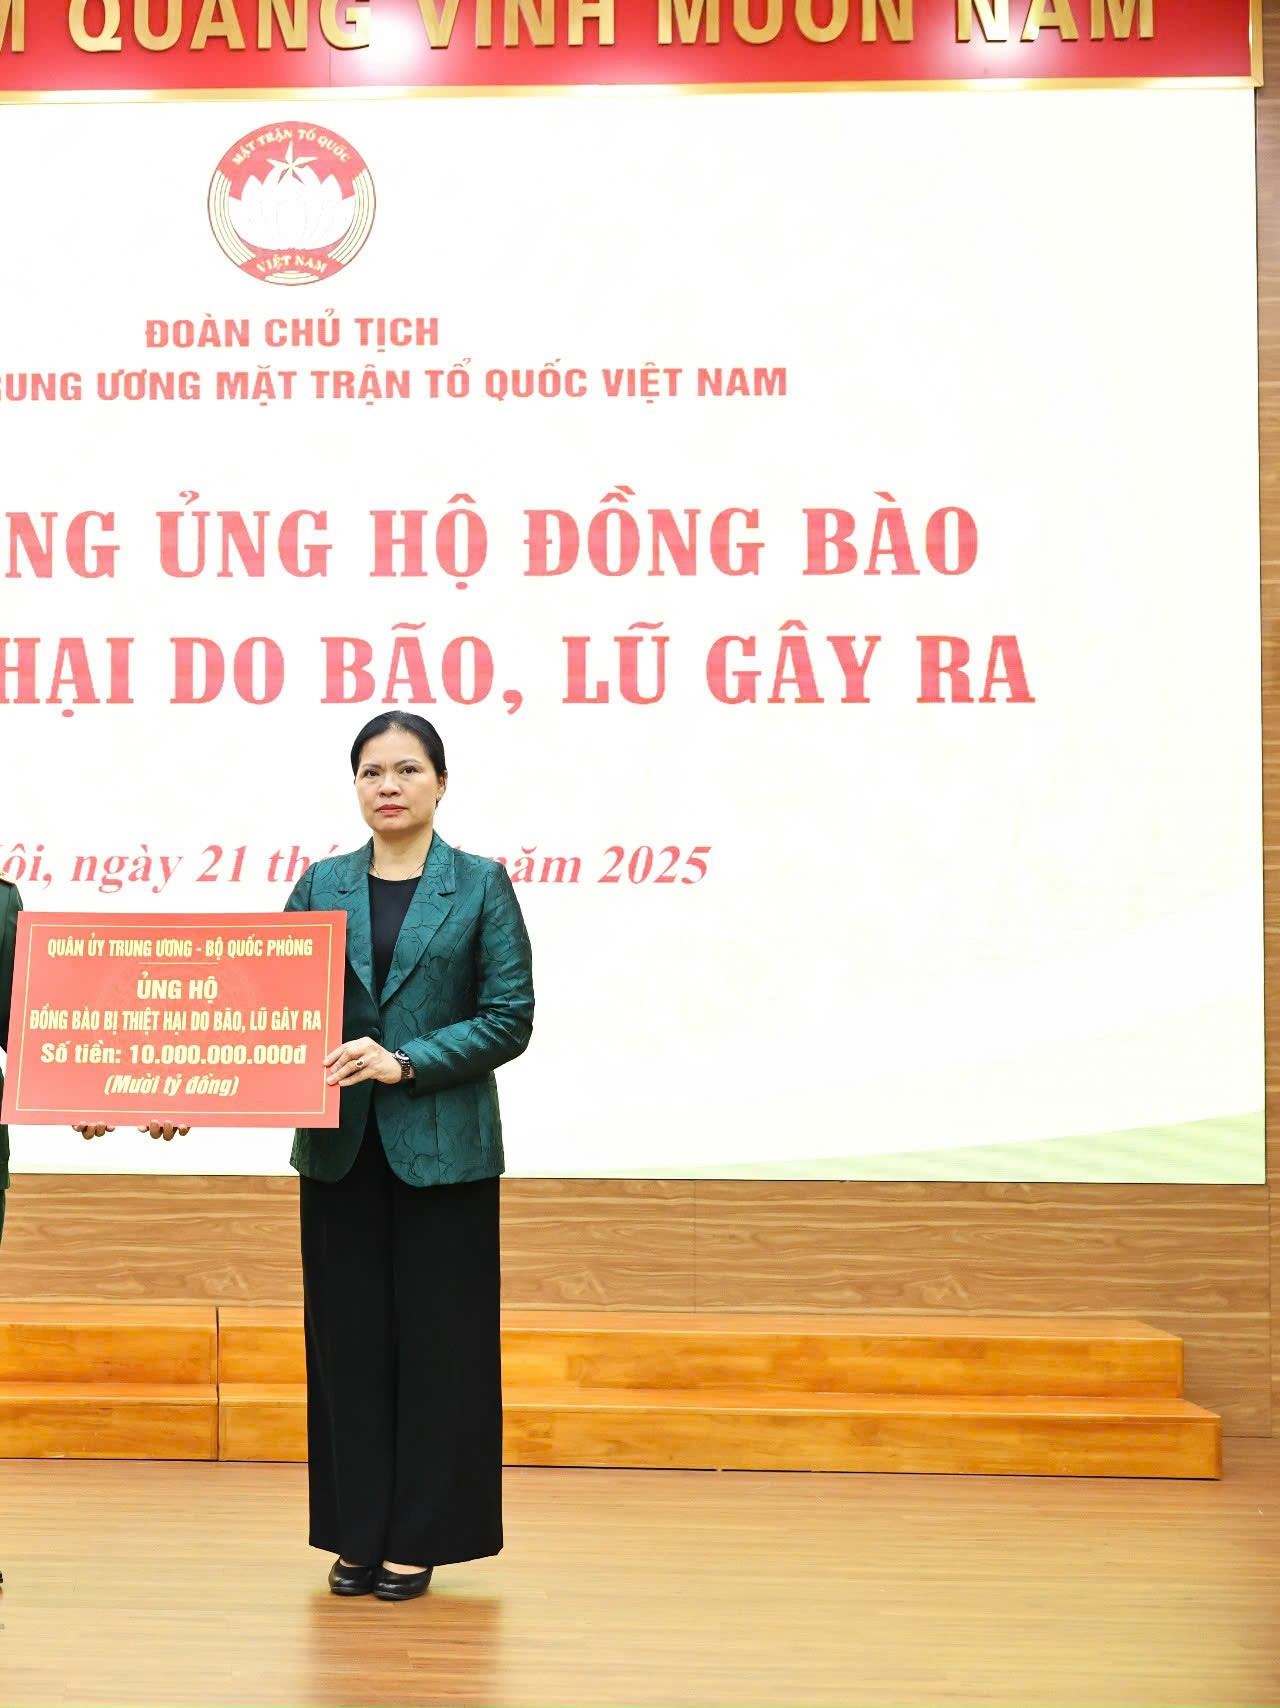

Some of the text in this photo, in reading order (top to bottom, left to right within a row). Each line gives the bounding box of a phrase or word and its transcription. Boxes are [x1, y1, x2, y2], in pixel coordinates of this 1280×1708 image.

[68, 0, 370, 52] QUANG
[419, 0, 615, 49] VINH
[956, 0, 1155, 42] NAM
[295, 255, 328, 273] NAM
[145, 308, 439, 353] ĐOÀN CHỦ TỊCH
[97, 369, 201, 401] ƯƠNG
[216, 365, 298, 406] MẶT
[310, 364, 410, 406] TRẬN
[424, 357, 472, 399] TỔ
[485, 358, 587, 401] QUỐC
[601, 362, 683, 404] VIỆT
[697, 367, 787, 397] NAM
[155, 489, 333, 578] ỦNG
[369, 493, 488, 591] HỘ
[523, 485, 766, 577] ĐỒNG
[802, 491, 979, 576] BÀO
[169, 636, 285, 705] DO
[319, 621, 523, 715] BÃO,
[562, 621, 670, 705] LŨ
[705, 619, 882, 705] GÂY
[916, 634, 1036, 704] RA
[70, 844, 183, 893] ngày
[195, 844, 249, 883] 21
[488, 845, 713, 885] ăm 2025
[47, 935, 85, 957] QUÂN
[87, 932, 106, 957] ỦY
[108, 939, 152, 957] TRUNG
[155, 938, 193, 957] ƯƠNG
[205, 936, 224, 961] BỘ
[227, 934, 263, 958] QUỐC
[266, 934, 313, 957] PHÒNG
[136, 971, 219, 1004] ỦNG HỘ
[71, 1006, 100, 1031] BÀO
[103, 1010, 119, 1035] BỊ
[122, 1006, 160, 1036] THIỆT
[162, 1010, 187, 1036] HẠI
[190, 1010, 210, 1031] DO
[213, 1007, 246, 1033] BÃO,
[249, 1007, 268, 1031] LŨ
[271, 1006, 299, 1031] GÂY
[302, 1010, 322, 1031] RA
[40, 1039, 308, 1065] Số tiền: 10.000.000.000đ
[103, 1072, 240, 1097] (Mười tỷ đồng)
